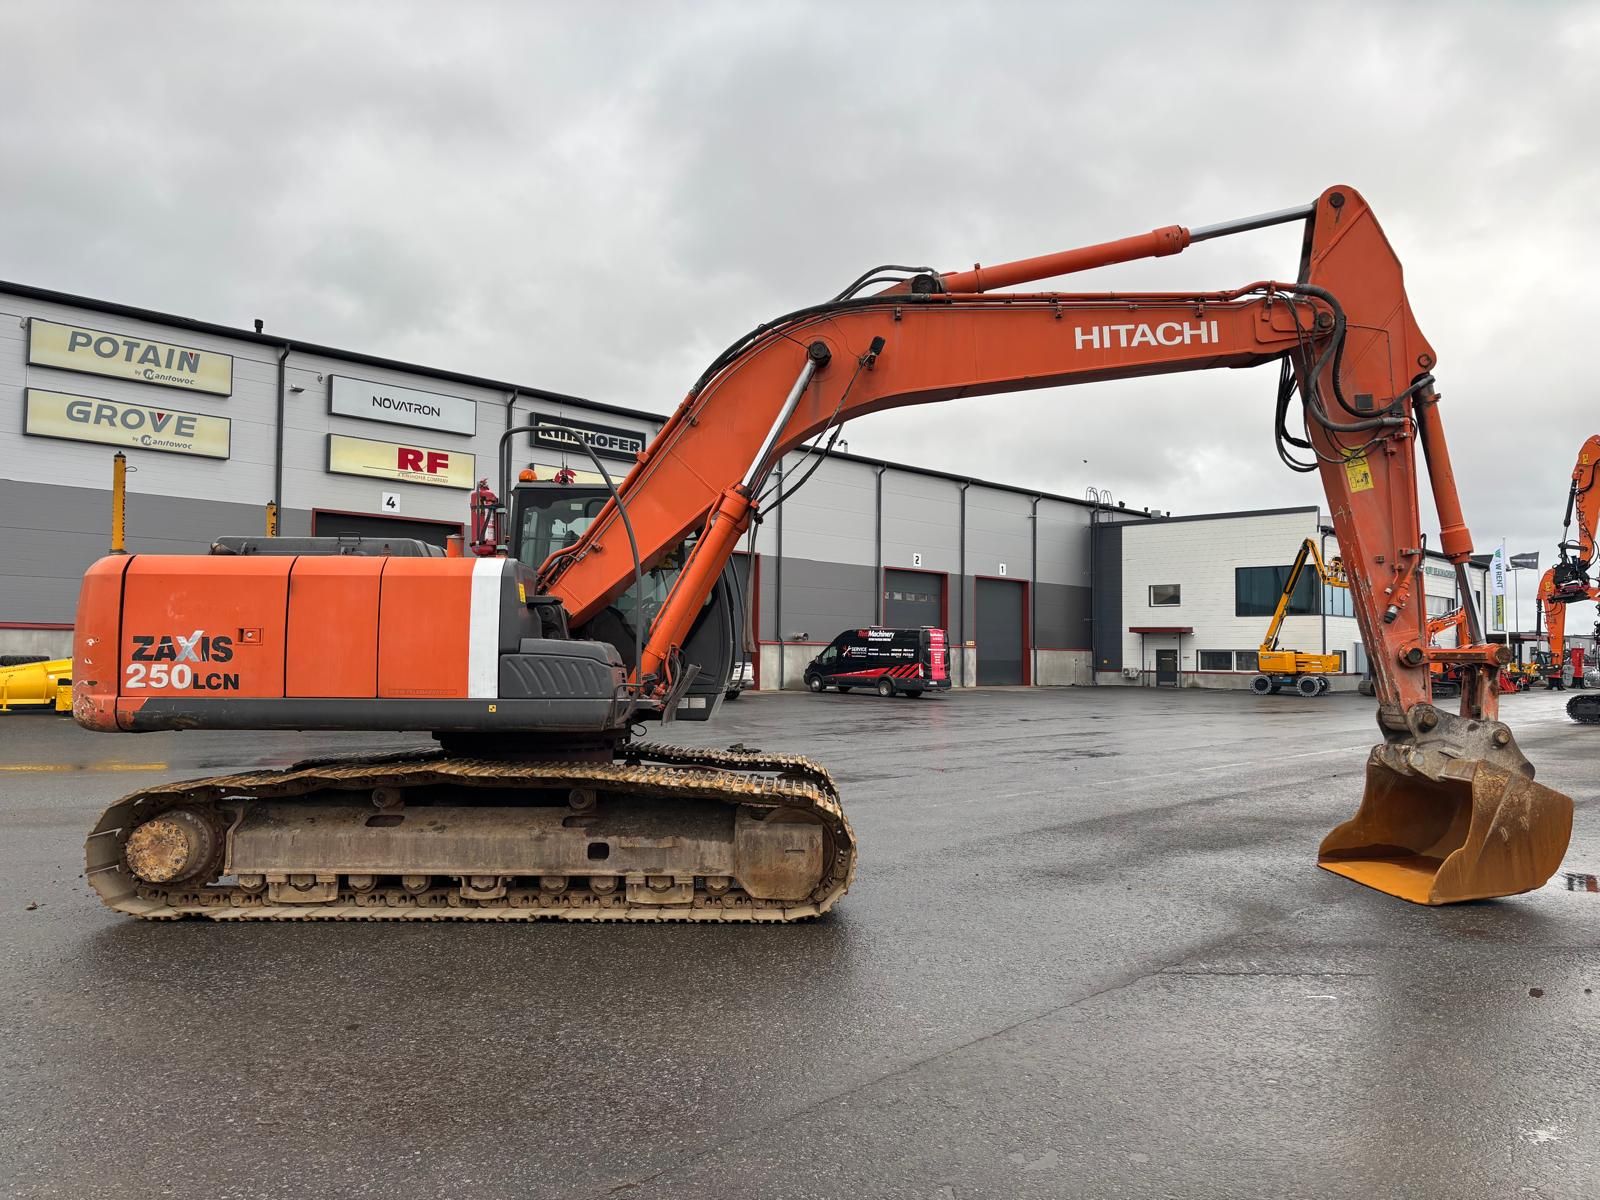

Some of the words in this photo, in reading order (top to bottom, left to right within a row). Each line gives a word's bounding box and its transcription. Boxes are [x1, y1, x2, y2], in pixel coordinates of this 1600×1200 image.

[1074, 320, 1219, 350] HITACHI
[68, 330, 201, 374] POTAIN
[143, 368, 195, 385] Manitowoc
[372, 395, 441, 417] NOVATRON
[66, 400, 198, 438] GROVE
[140, 434, 193, 450] Manitowoc
[397, 447, 449, 474] RF
[427, 476, 449, 484] COMPANY
[386, 497, 396, 509] 4
[915, 555, 920, 564] 2
[1496, 571, 1504, 588] RENT
[132, 630, 234, 662] ZAXIS
